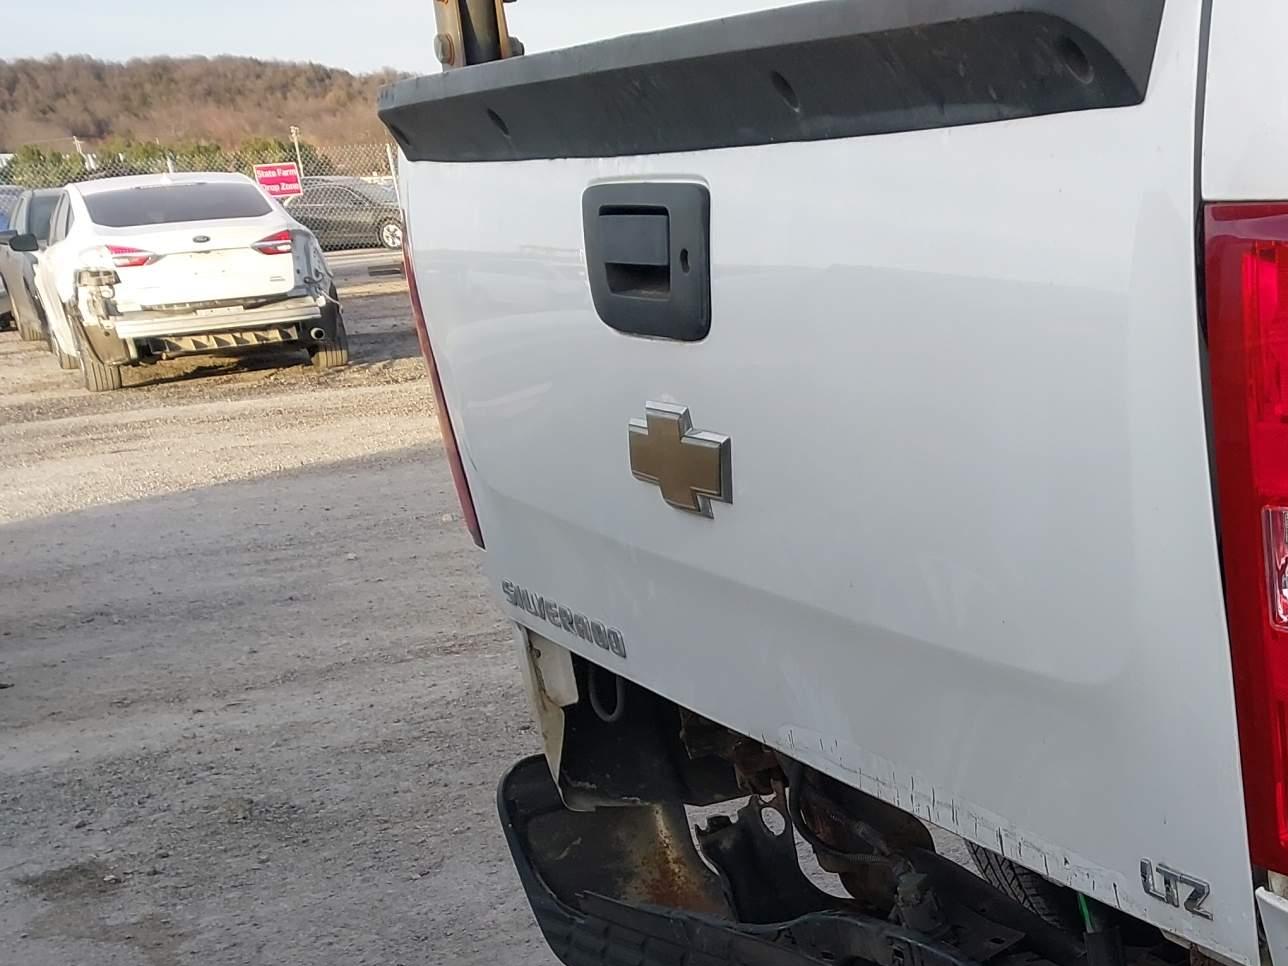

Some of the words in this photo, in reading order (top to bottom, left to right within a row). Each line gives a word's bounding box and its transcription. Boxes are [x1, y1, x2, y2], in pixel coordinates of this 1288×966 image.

[256, 169, 277, 177] State
[277, 168, 297, 176] Farm
[280, 182, 299, 190] Zone
[502, 577, 627, 659] SILVERADO
[1139, 857, 1214, 921] LTZ
